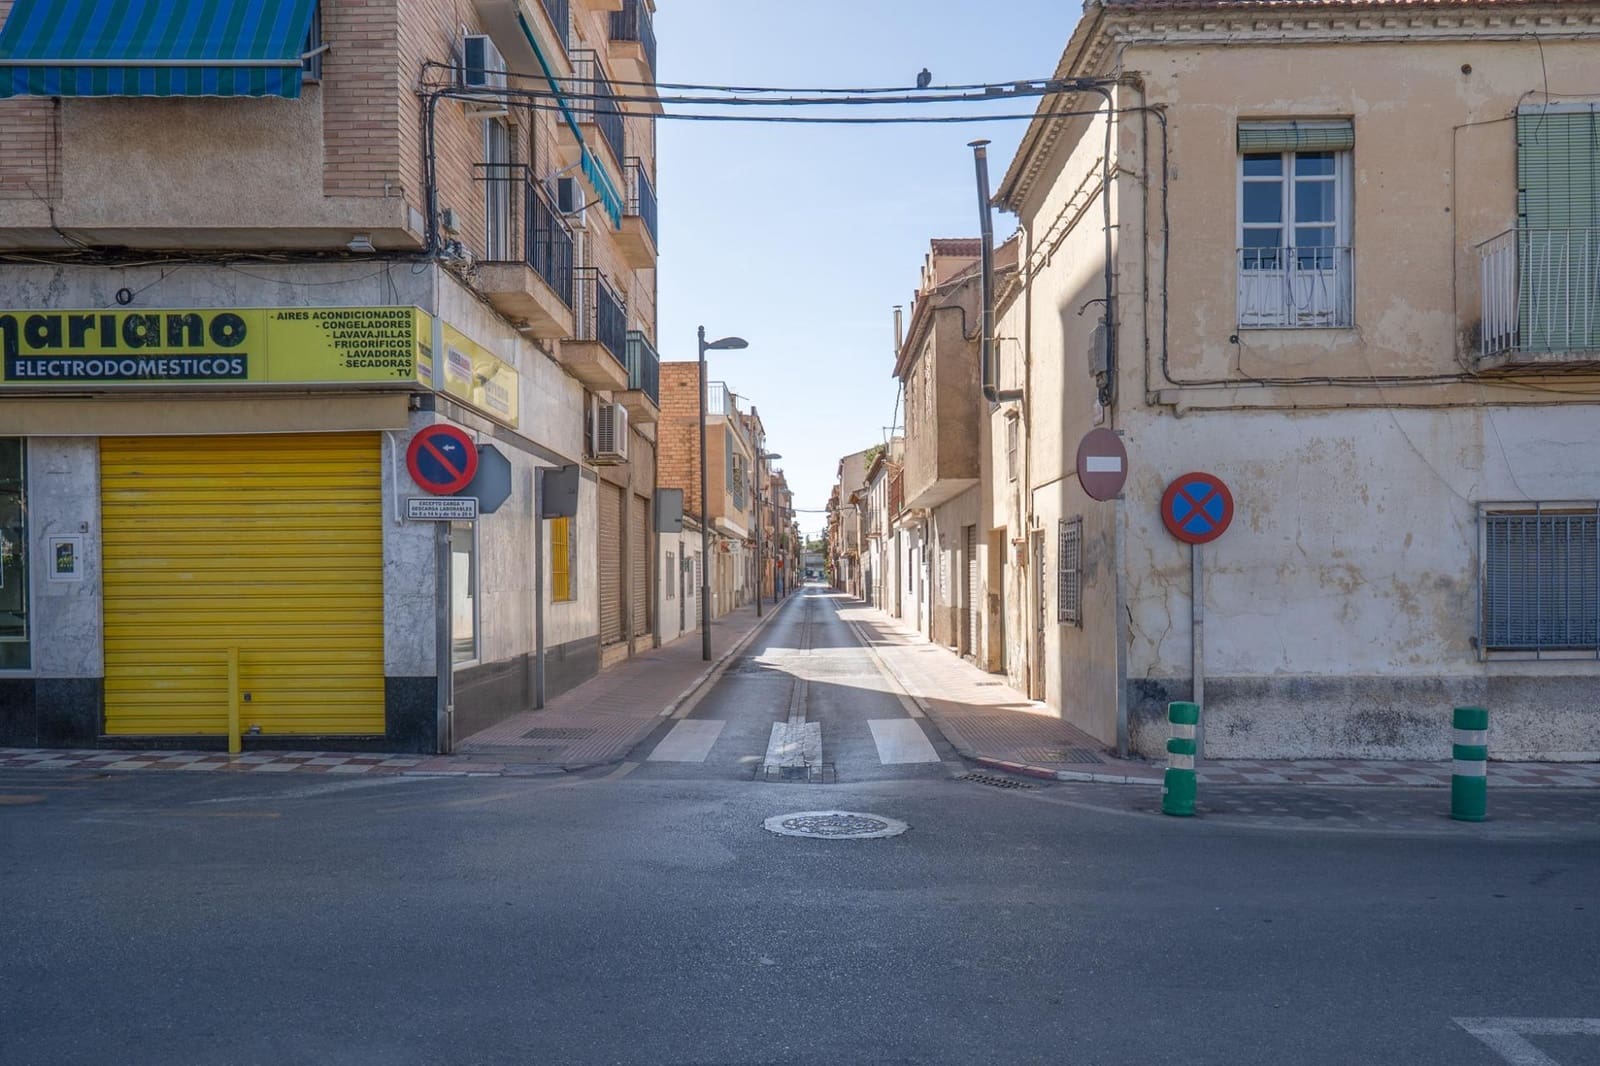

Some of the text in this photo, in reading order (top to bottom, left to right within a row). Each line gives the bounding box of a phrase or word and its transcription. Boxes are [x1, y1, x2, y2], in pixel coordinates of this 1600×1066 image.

[277, 312, 309, 320] AIRES
[313, 311, 411, 319] ACONDICIONADOS
[323, 321, 411, 329] CONGELADORES
[333, 330, 411, 338] LAVAVAJILLAS
[335, 339, 411, 348] FRIGORÍFICOS
[347, 350, 411, 358] LAVADORAS
[15, 358, 243, 377] ELECTRODOMESTICOS
